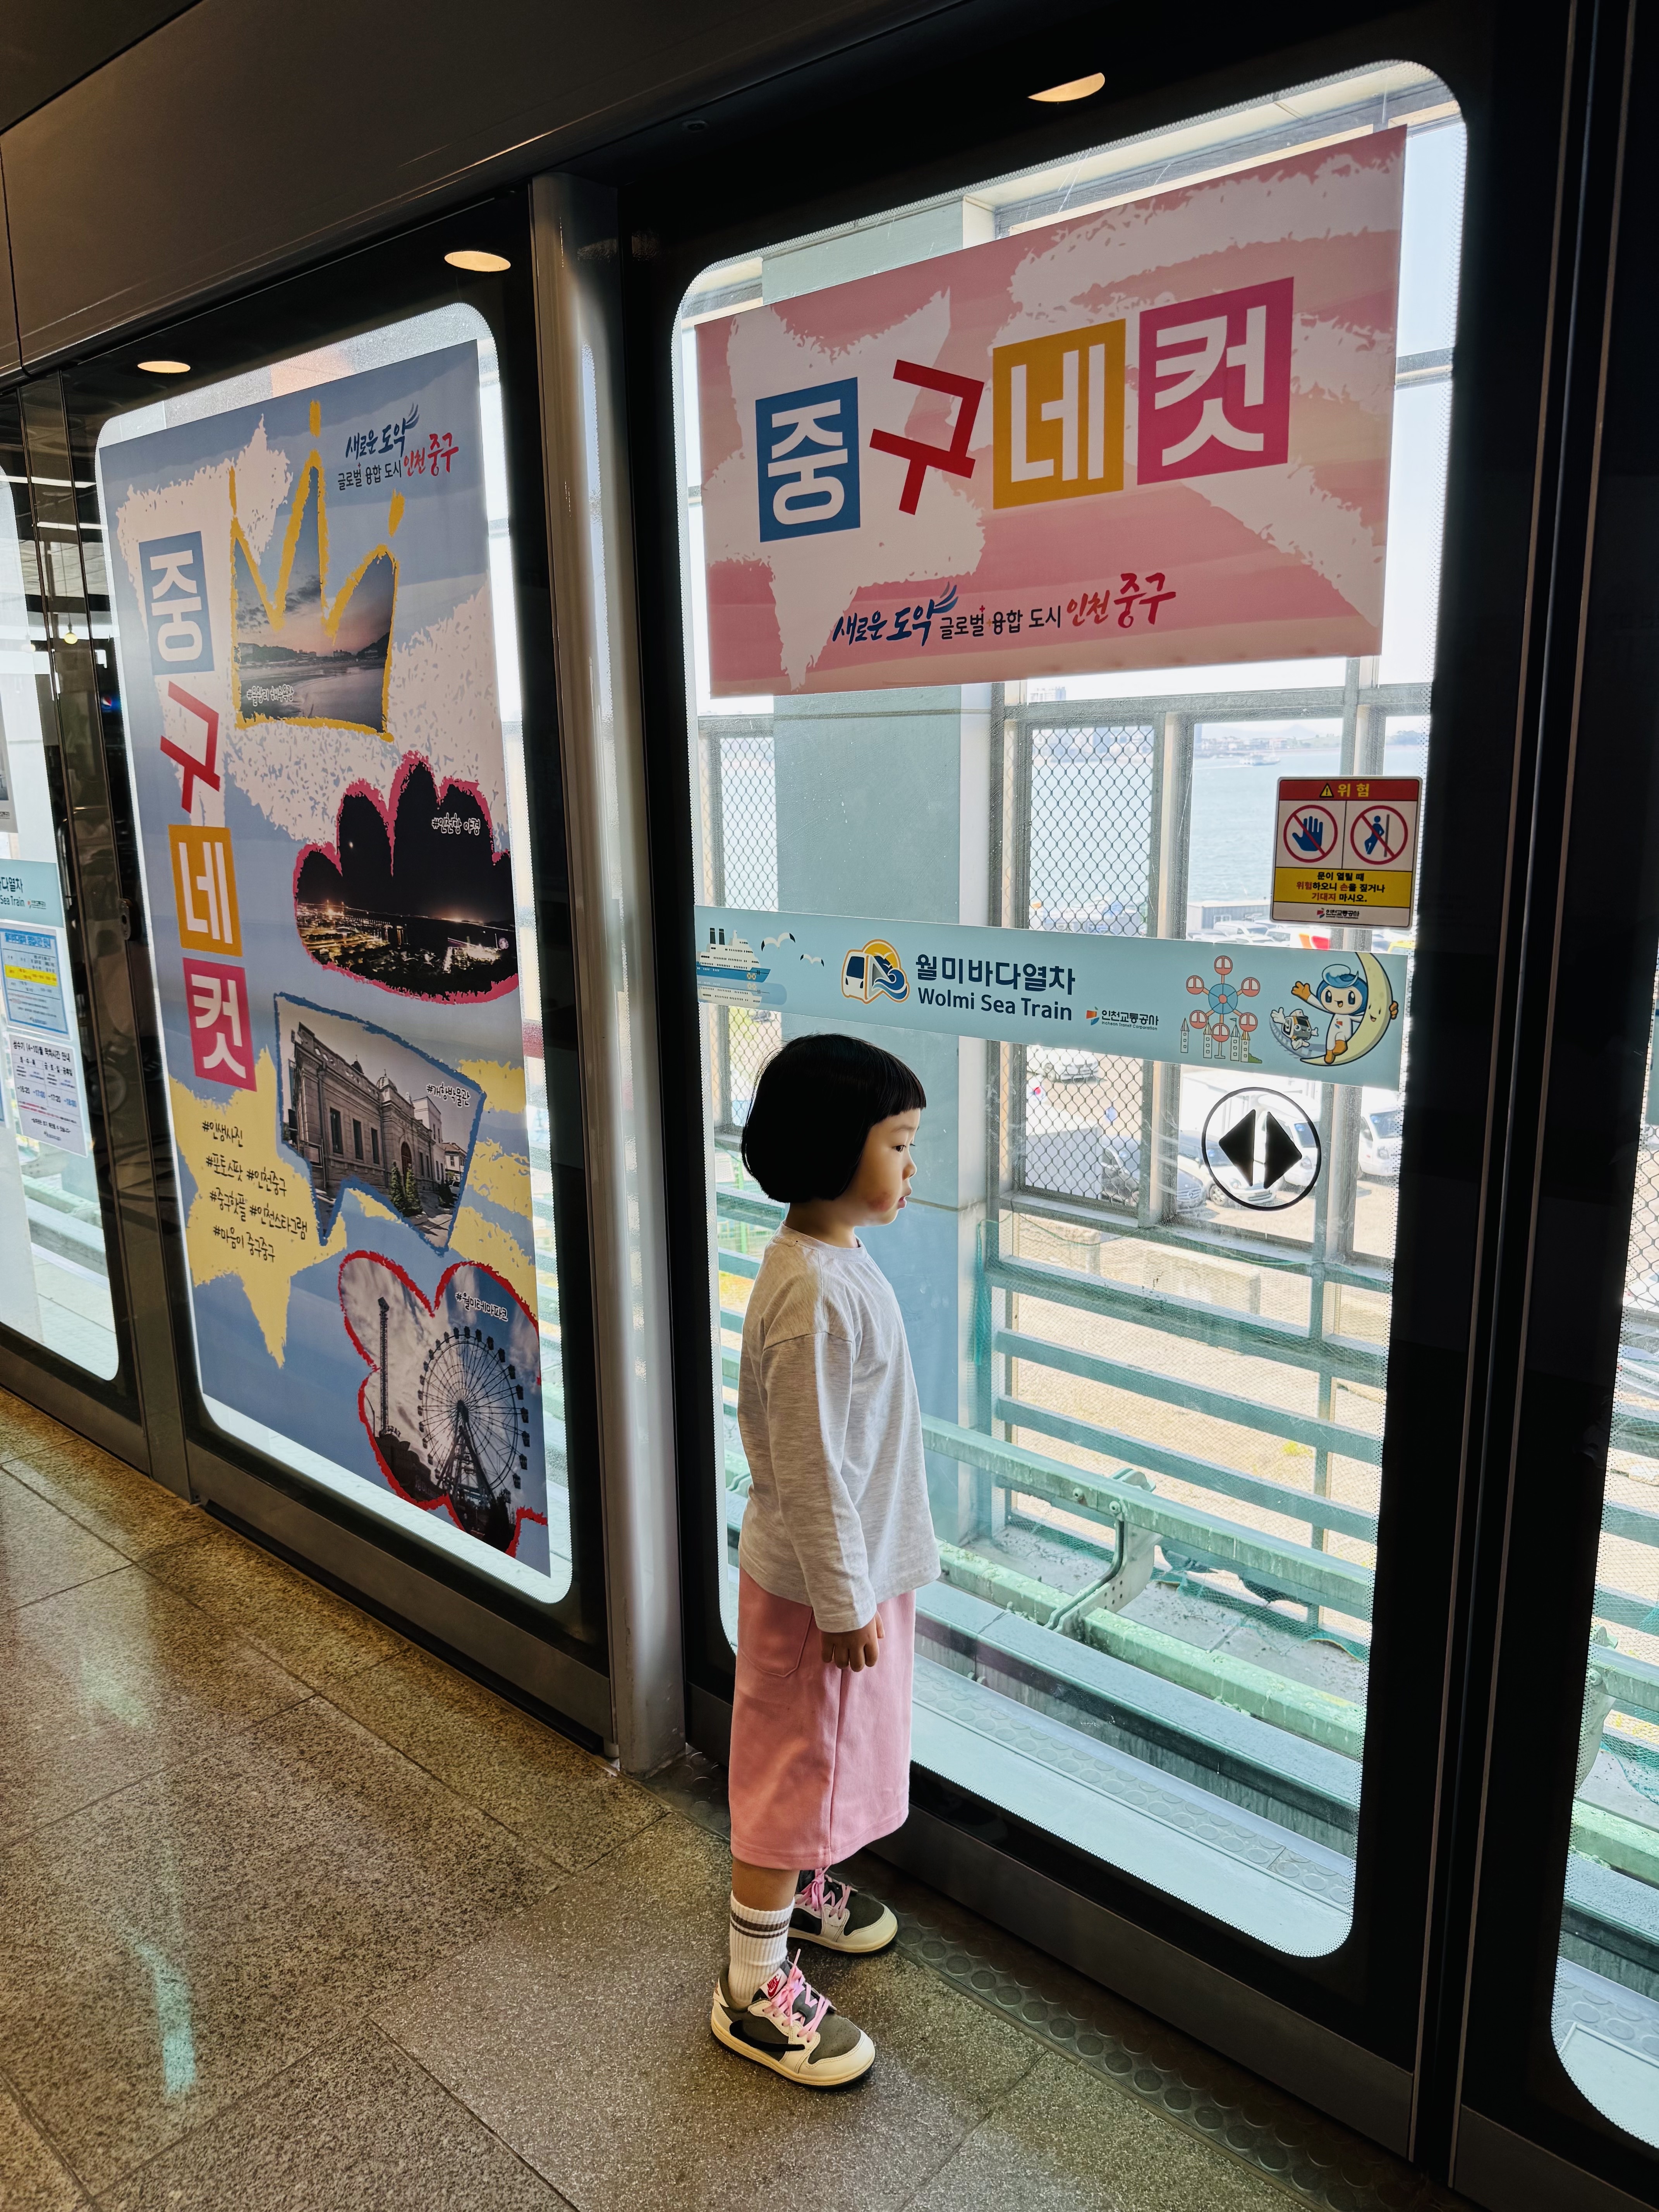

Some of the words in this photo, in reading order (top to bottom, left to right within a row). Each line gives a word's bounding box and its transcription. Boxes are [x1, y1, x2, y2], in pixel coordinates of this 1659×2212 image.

[345, 429, 378, 460] 새로운
[378, 418, 406, 458] 도약
[338, 468, 362, 491] 글로벌
[366, 465, 381, 485] 융합
[385, 460, 402, 478] 도시
[403, 448, 426, 476] 인천
[428, 433, 459, 476] 중구
[832, 611, 886, 642] 새로운
[886, 599, 935, 646] 도약
[940, 613, 984, 640] 글로벌
[992, 611, 1023, 635] 융합
[1029, 605, 1061, 629] 도시
[1067, 589, 1111, 627] 인천
[1113, 572, 1176, 629] 중구
[464, 818, 480, 835] 야경
[0, 877, 23, 893] 다열차
[1296, 881, 1337, 891] 위험하오니
[1340, 883, 1357, 892] 손을
[1317, 872, 1333, 881] 문이
[1336, 872, 1353, 881] 열릴
[1355, 873, 1364, 881] 때
[10, 896, 25, 907] Train
[1312, 893, 1336, 902] 기대지
[1339, 893, 1367, 903] 마시오.
[915, 954, 1075, 995] 월미바다열차
[918, 987, 975, 1010] Wolmi
[981, 994, 1015, 1015] Sea
[1021, 998, 1072, 1021] Train
[1102, 1010, 1159, 1025] 인천교통공사
[426, 1082, 471, 1107] #개항박물관
[202, 1121, 243, 1147] #인생사진
[206, 1153, 243, 1182] #포토스팟
[247, 1166, 287, 1197] #인천중구
[249, 1202, 307, 1240] #인천스타그램
[213, 1225, 244, 1249] #마음이
[246, 1232, 275, 1262] 중구중구
[455, 1291, 508, 1322] #월미테마파크
[767, 1975, 778, 1991] NIKE
